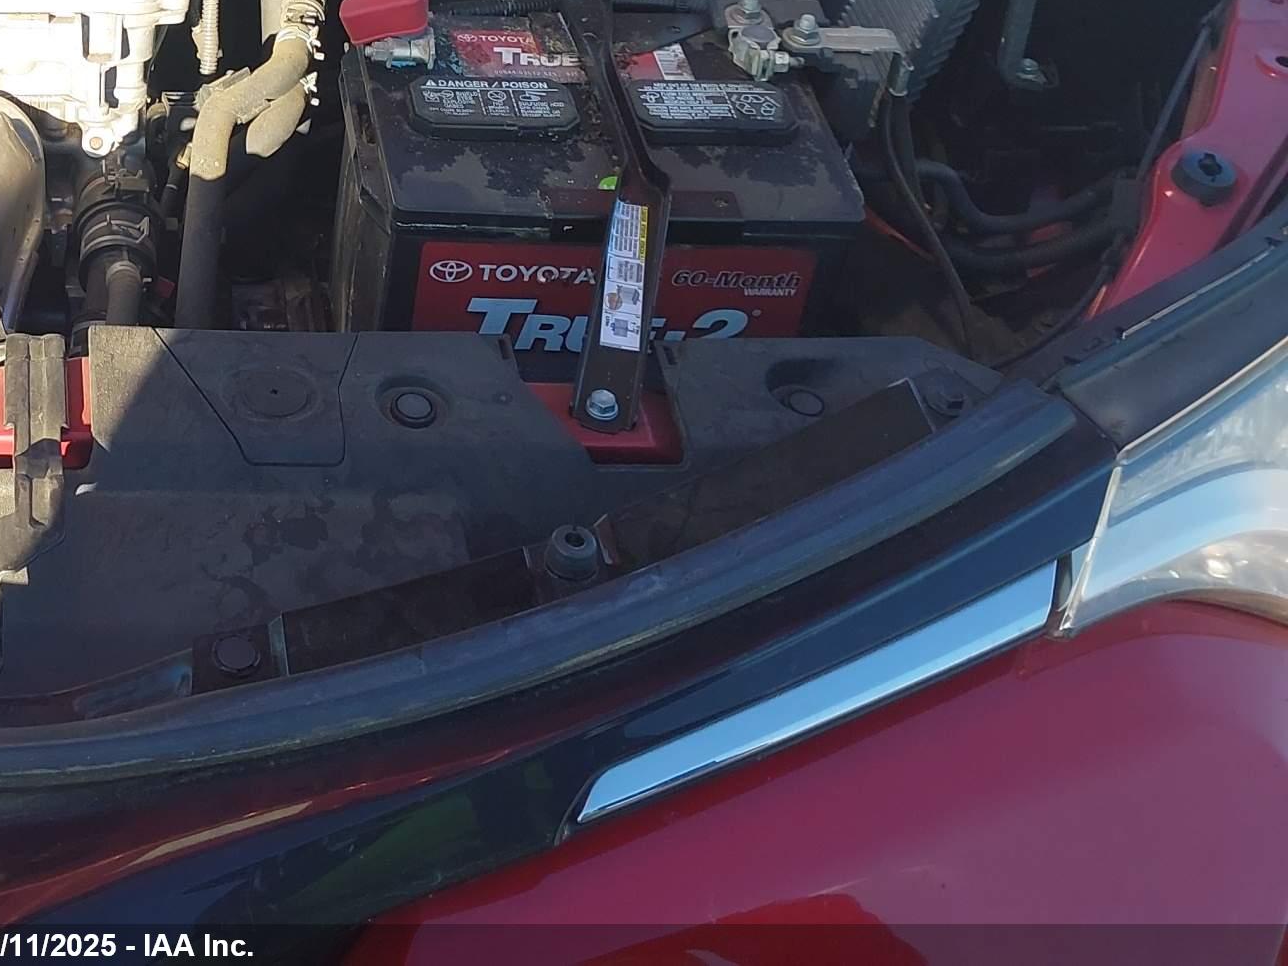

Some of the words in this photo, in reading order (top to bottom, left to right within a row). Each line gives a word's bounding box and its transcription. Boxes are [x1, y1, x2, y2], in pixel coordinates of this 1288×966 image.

[479, 34, 536, 44] TOYOTA
[438, 79, 489, 88] DANGER
[502, 81, 549, 89] POISON
[478, 264, 596, 285] TOYOTA
[672, 269, 802, 288] 60-Month
[743, 288, 797, 297] WARRANTY
[467, 297, 749, 354] TR-2
